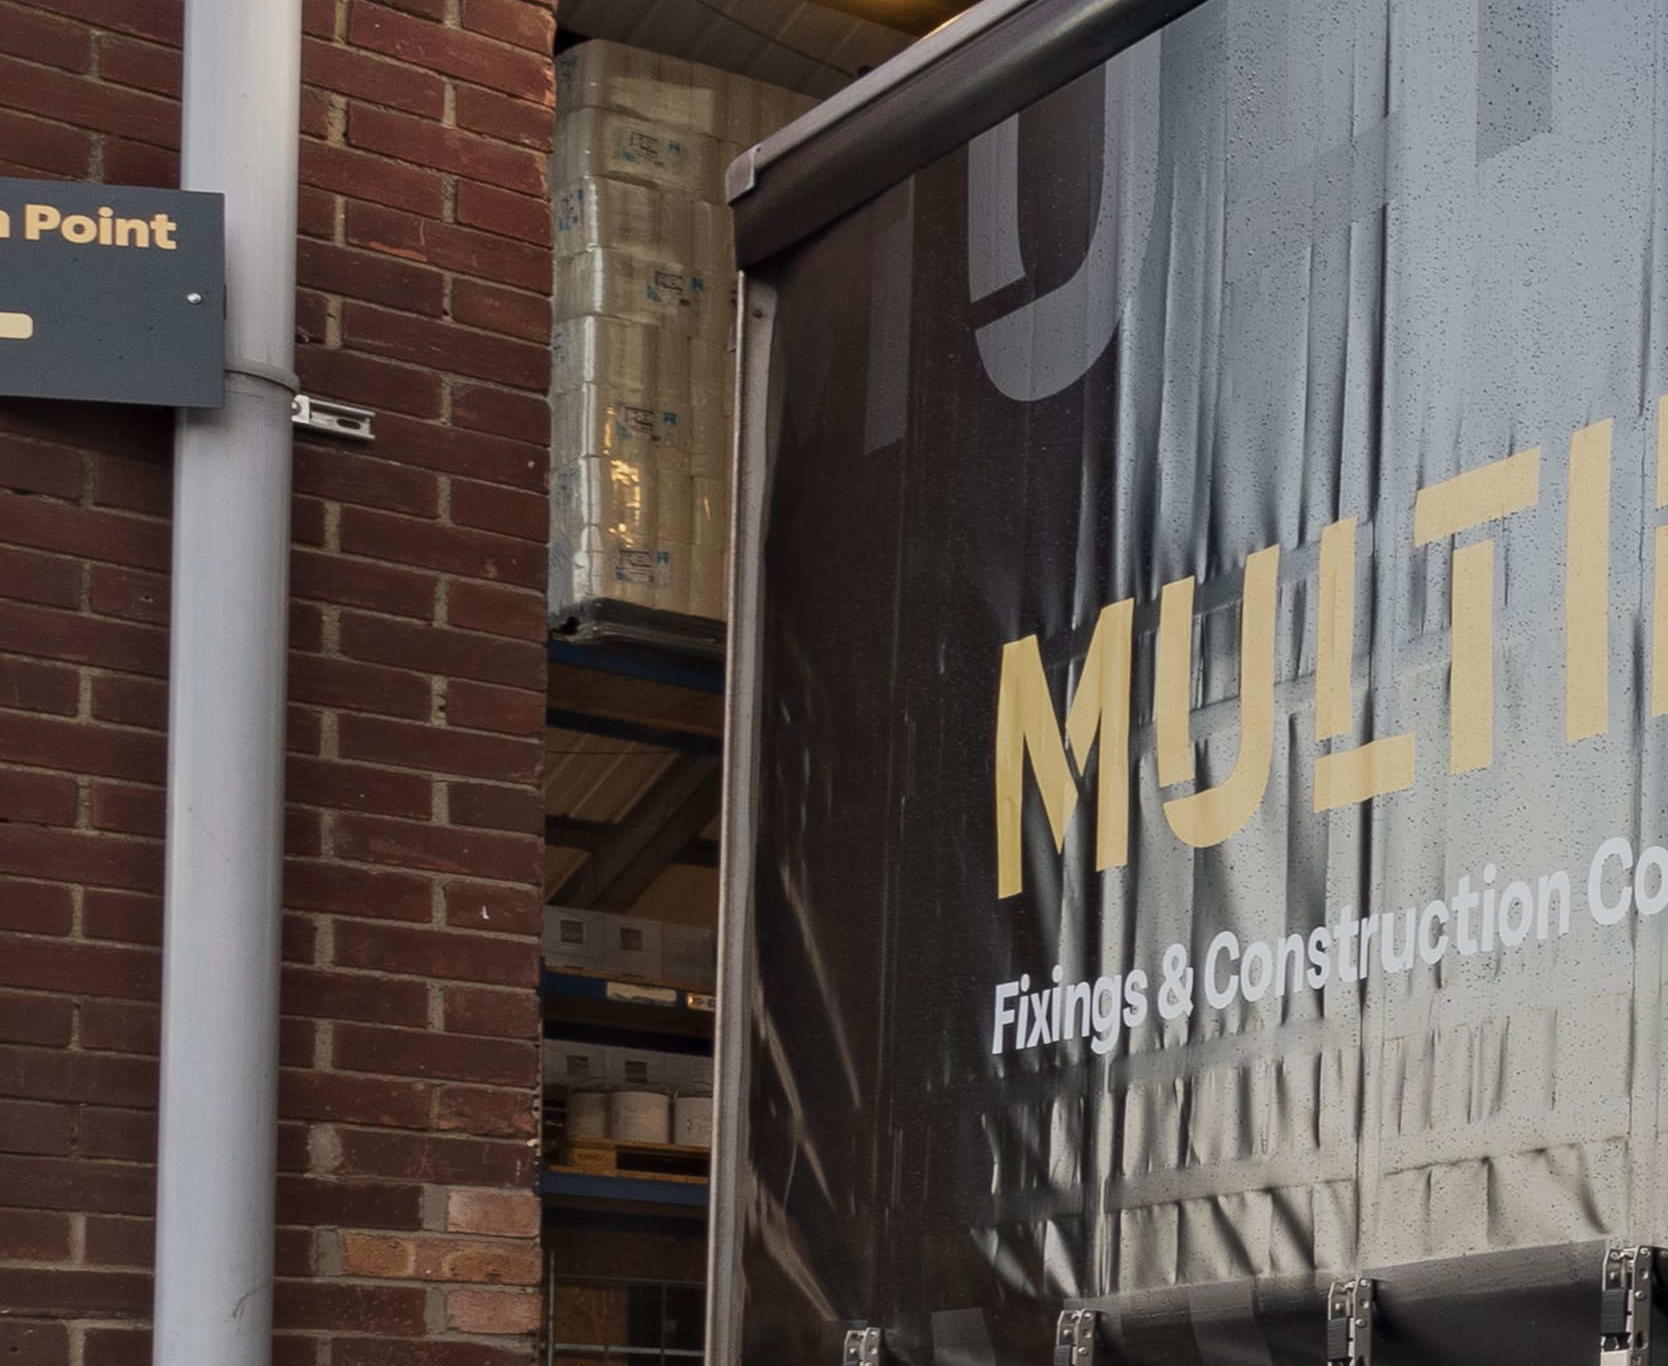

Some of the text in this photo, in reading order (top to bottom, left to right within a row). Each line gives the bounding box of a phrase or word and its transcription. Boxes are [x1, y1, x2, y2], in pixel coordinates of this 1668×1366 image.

[25, 203, 177, 250] Point
[991, 964, 1148, 1055] Fixings
[1157, 942, 1195, 1022] &
[1202, 861, 1572, 1009] Construction
